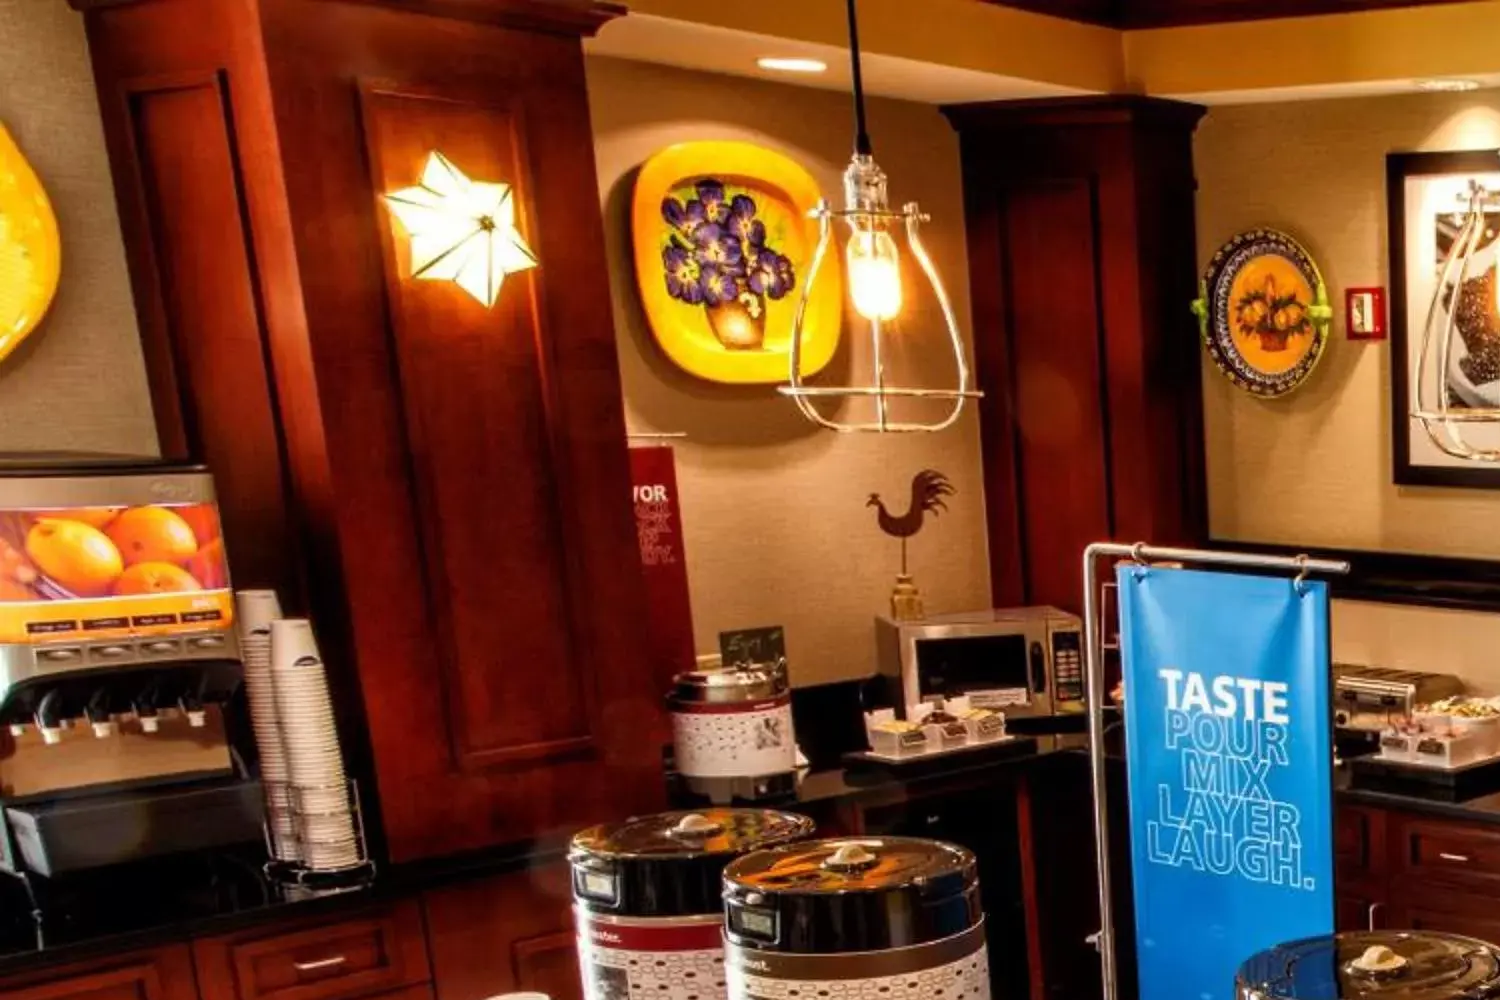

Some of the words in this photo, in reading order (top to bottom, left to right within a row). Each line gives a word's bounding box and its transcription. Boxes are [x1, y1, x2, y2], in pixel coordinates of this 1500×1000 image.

[1159, 668, 1289, 724] TASTE
[1165, 705, 1289, 766] POUR
[1181, 747, 1273, 803] MIX
[1158, 783, 1302, 849] LAYER
[1147, 819, 1316, 891] LAUGH.
